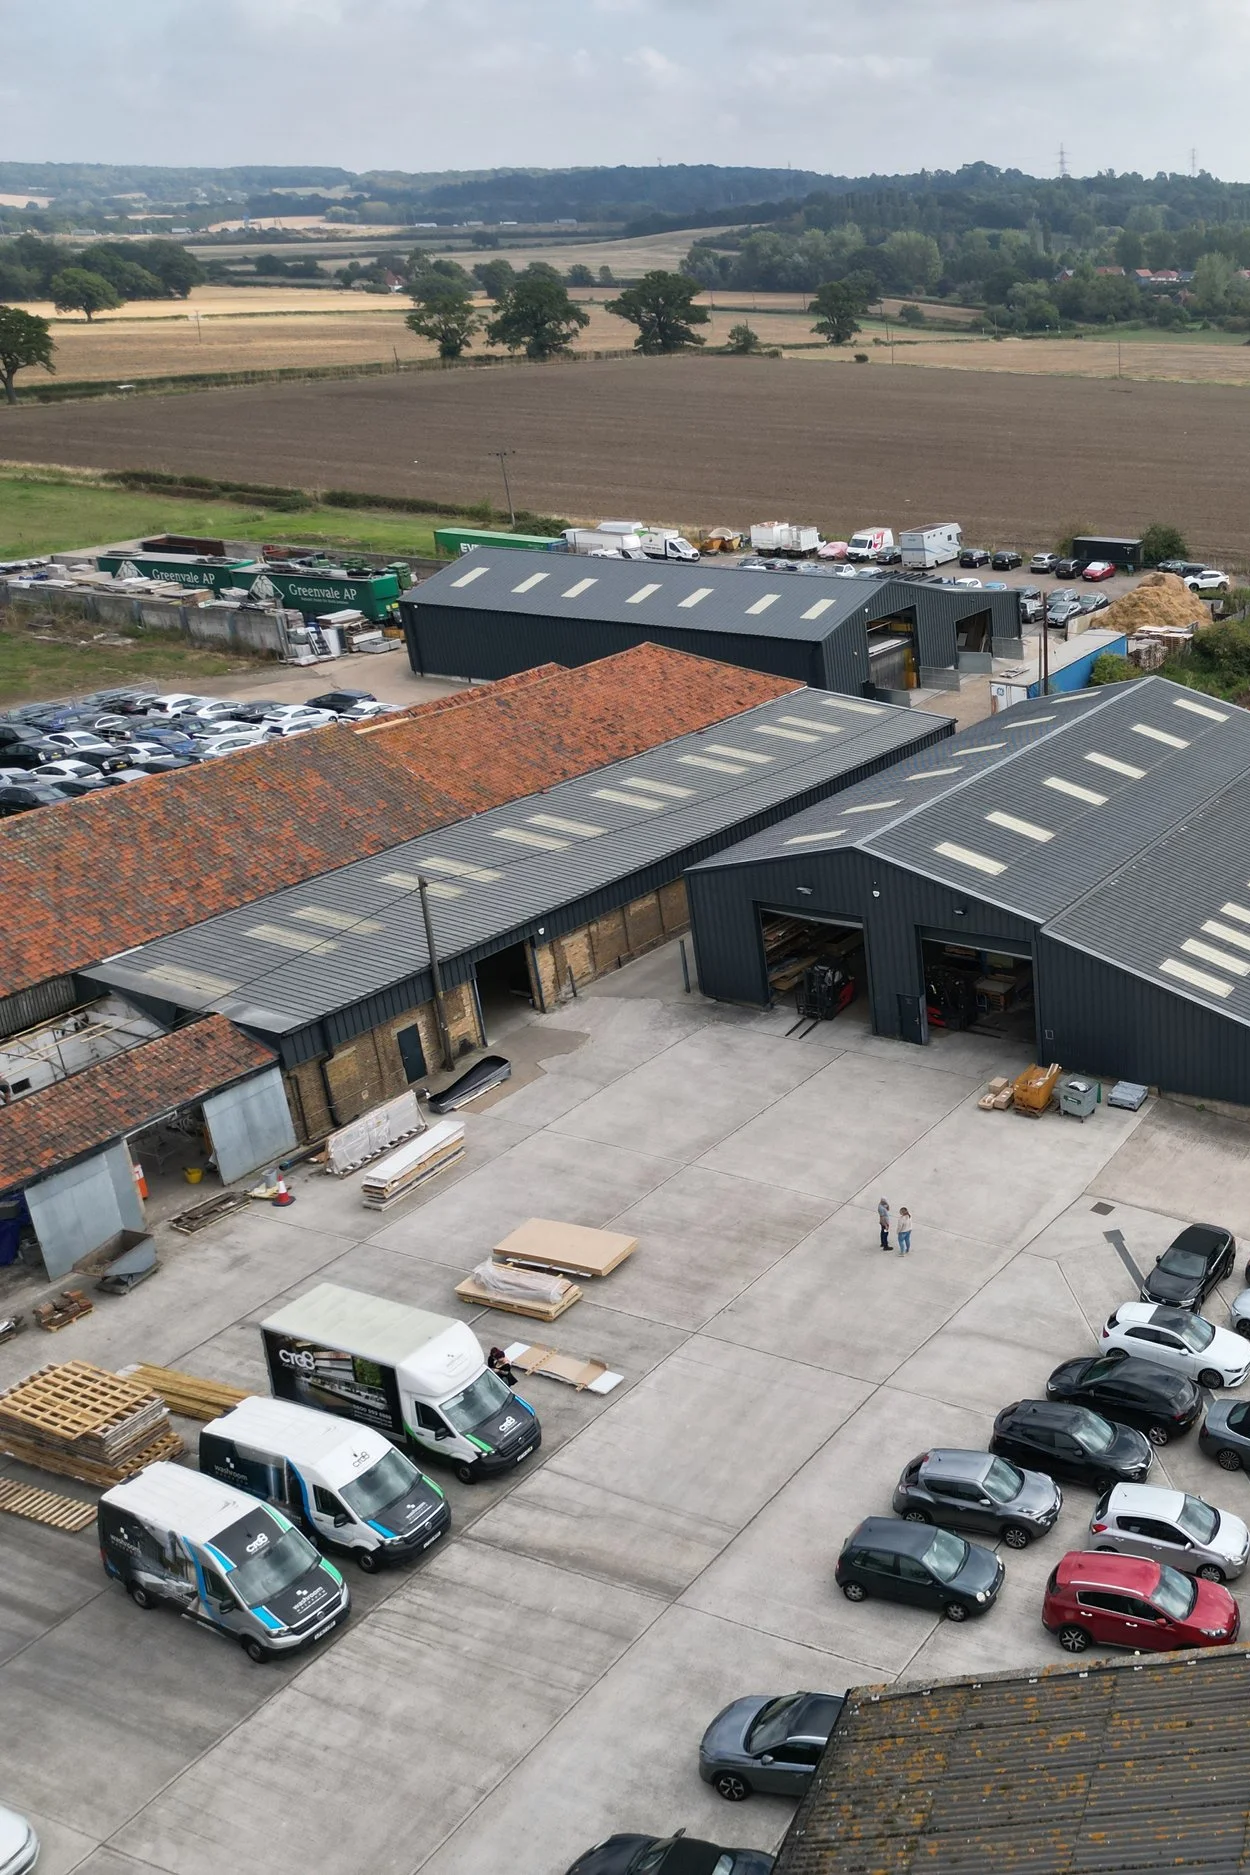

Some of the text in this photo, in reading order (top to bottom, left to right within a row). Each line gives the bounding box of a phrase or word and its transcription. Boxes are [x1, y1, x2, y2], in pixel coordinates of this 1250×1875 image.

[152, 568, 216, 585] Greenvale AP
[288, 583, 357, 600] Greenvale AP
[292, 1586, 324, 1610] washroom
